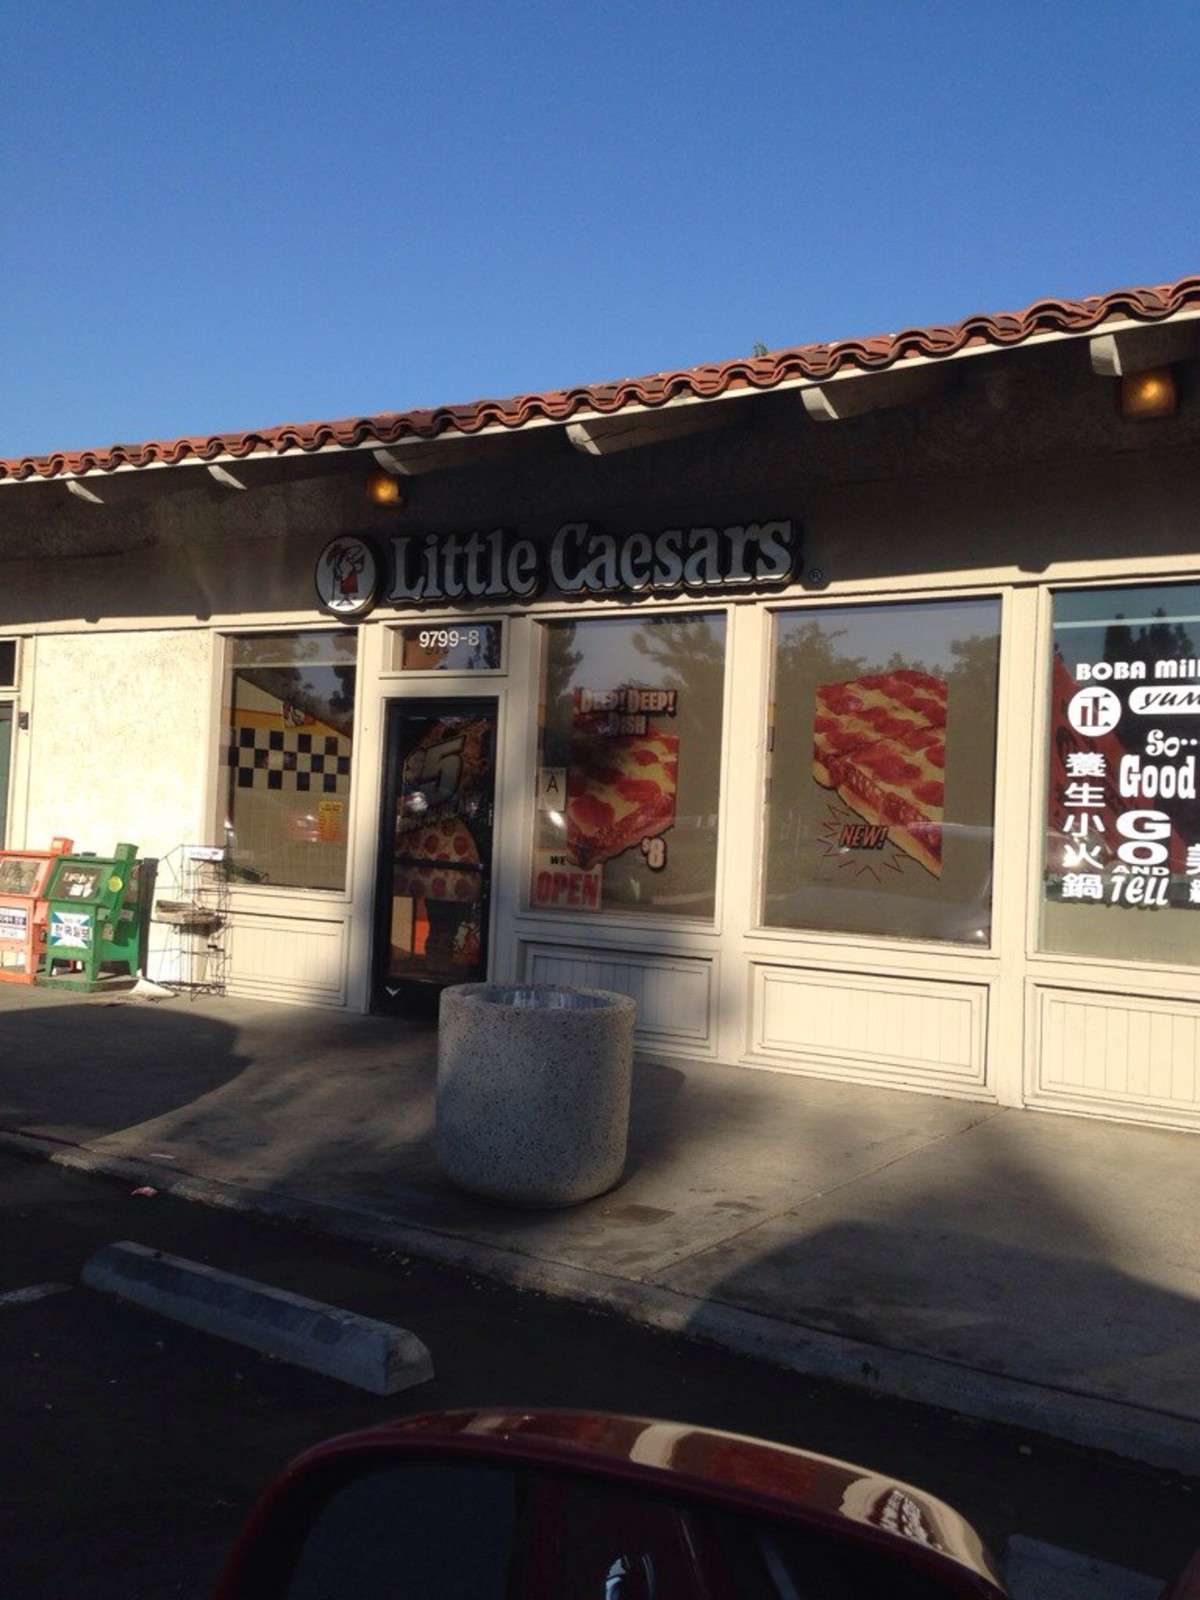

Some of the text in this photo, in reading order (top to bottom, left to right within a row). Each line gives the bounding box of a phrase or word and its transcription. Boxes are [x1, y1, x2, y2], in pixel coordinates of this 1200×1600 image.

[388, 520, 796, 602] Little Caesars
[1076, 661, 1146, 681] BOBA
[627, 689, 676, 714] DEEP!
[547, 775, 559, 793] A
[1119, 754, 1196, 799] Good
[839, 825, 889, 850] NEW!
[1112, 865, 1170, 876] AND
[537, 871, 600, 908] OPEN
